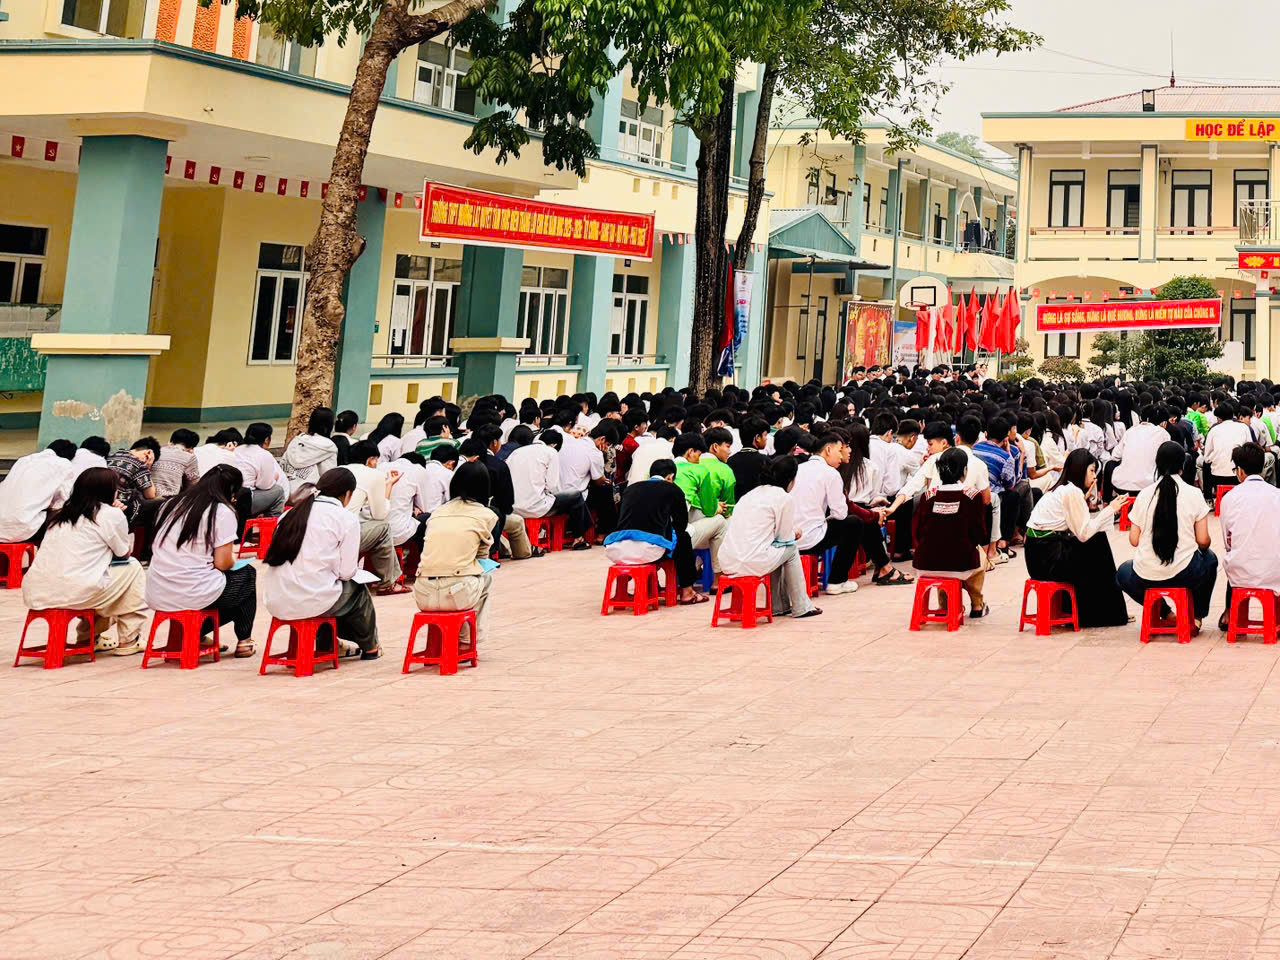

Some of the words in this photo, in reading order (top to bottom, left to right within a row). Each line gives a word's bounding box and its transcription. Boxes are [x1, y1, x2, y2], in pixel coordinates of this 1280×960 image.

[1195, 123, 1223, 138] HỌC
[1227, 119, 1246, 136] ĐỂ
[1250, 123, 1275, 138] LẬP
